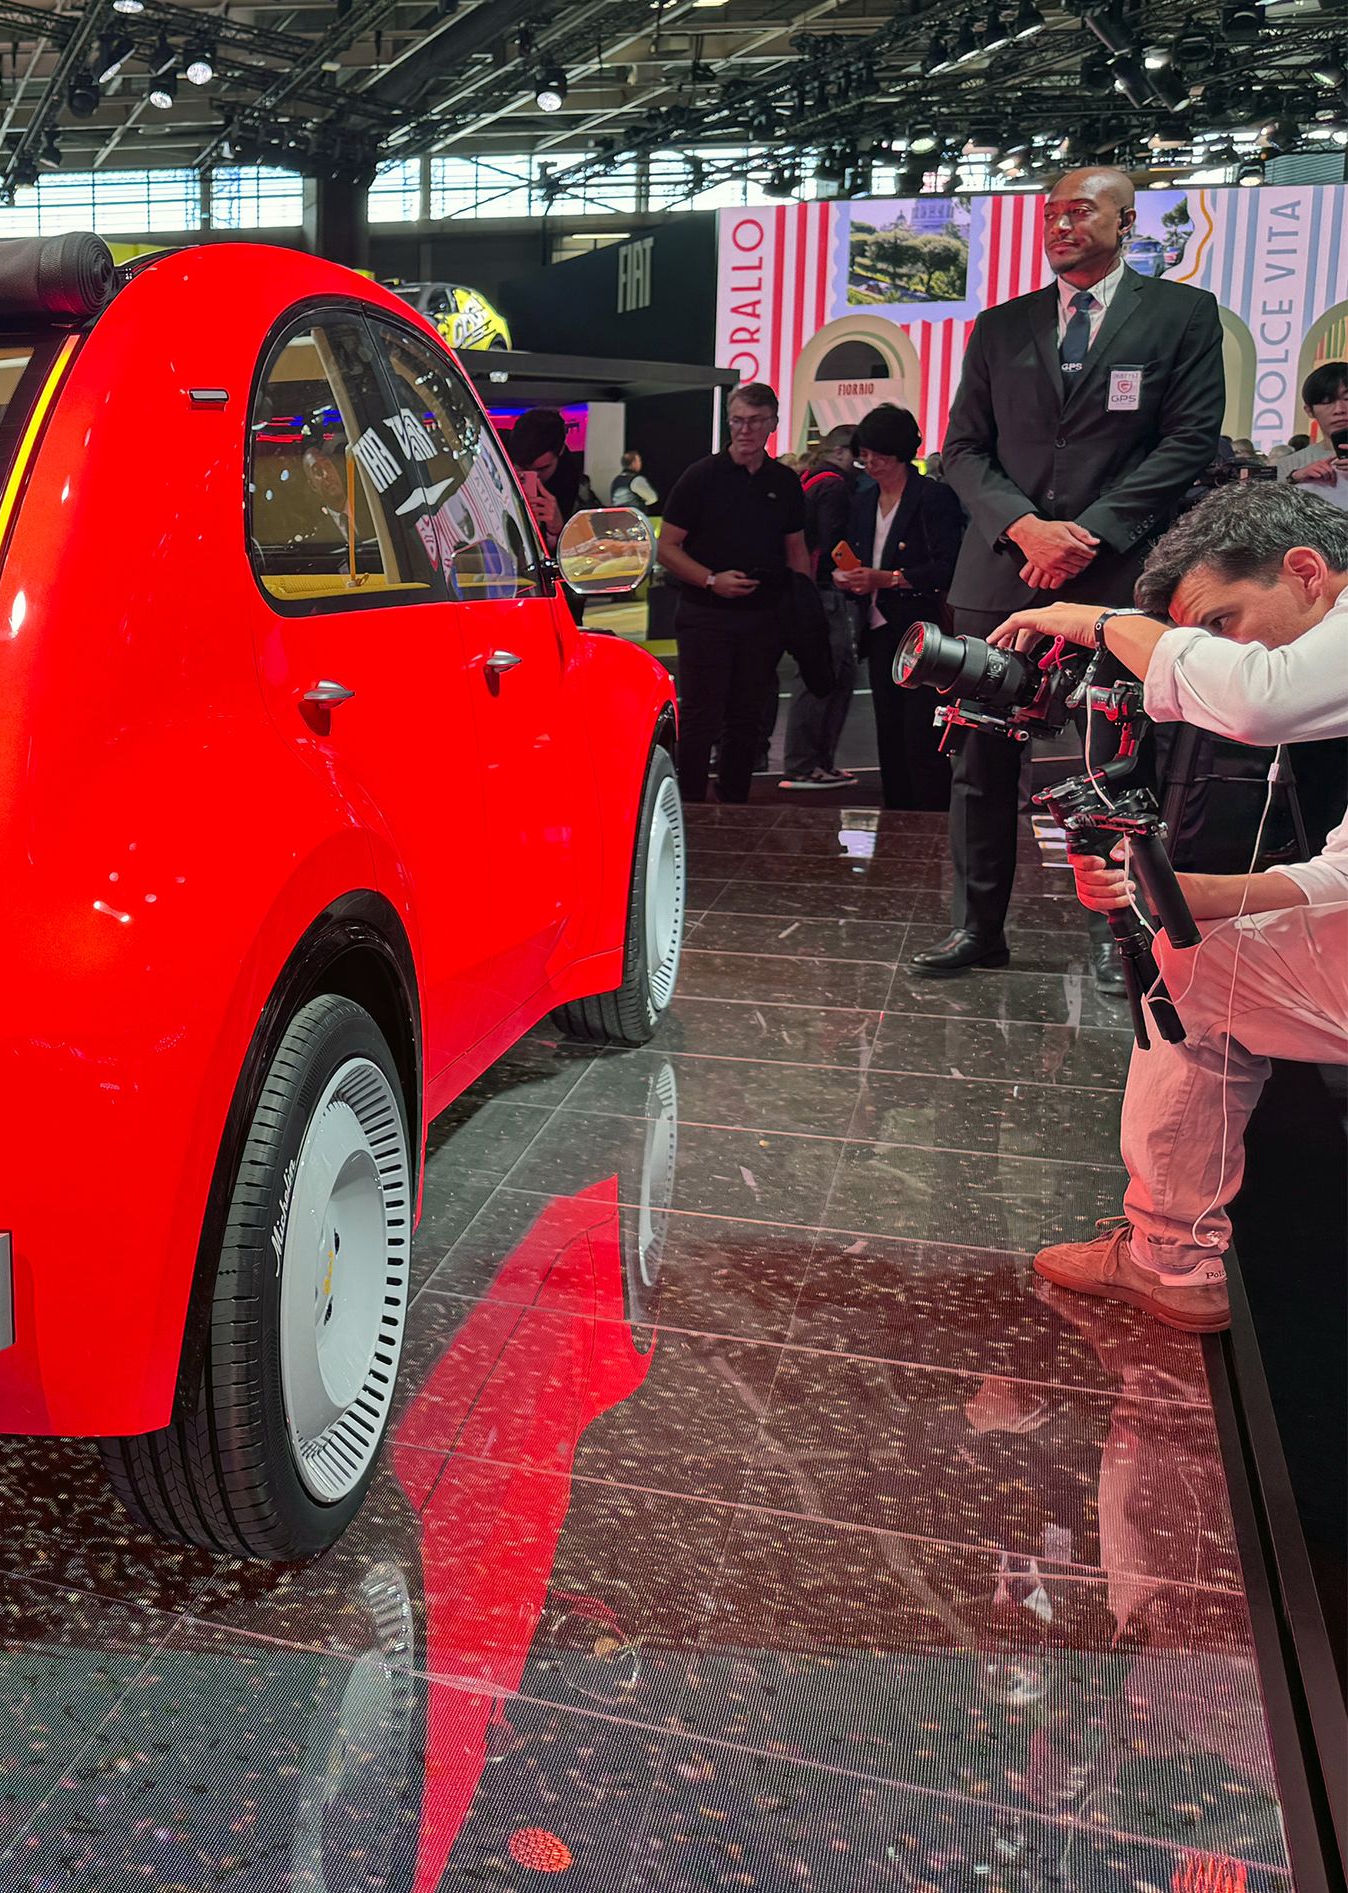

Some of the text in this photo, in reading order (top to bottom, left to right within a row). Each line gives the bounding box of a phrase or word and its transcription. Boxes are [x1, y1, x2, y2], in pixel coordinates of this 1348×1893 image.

[617, 236, 654, 314] FIAT
[1253, 199, 1301, 431] DOLCE VITA
[1061, 362, 1083, 371] GPS
[1111, 394, 1137, 403] GPS
